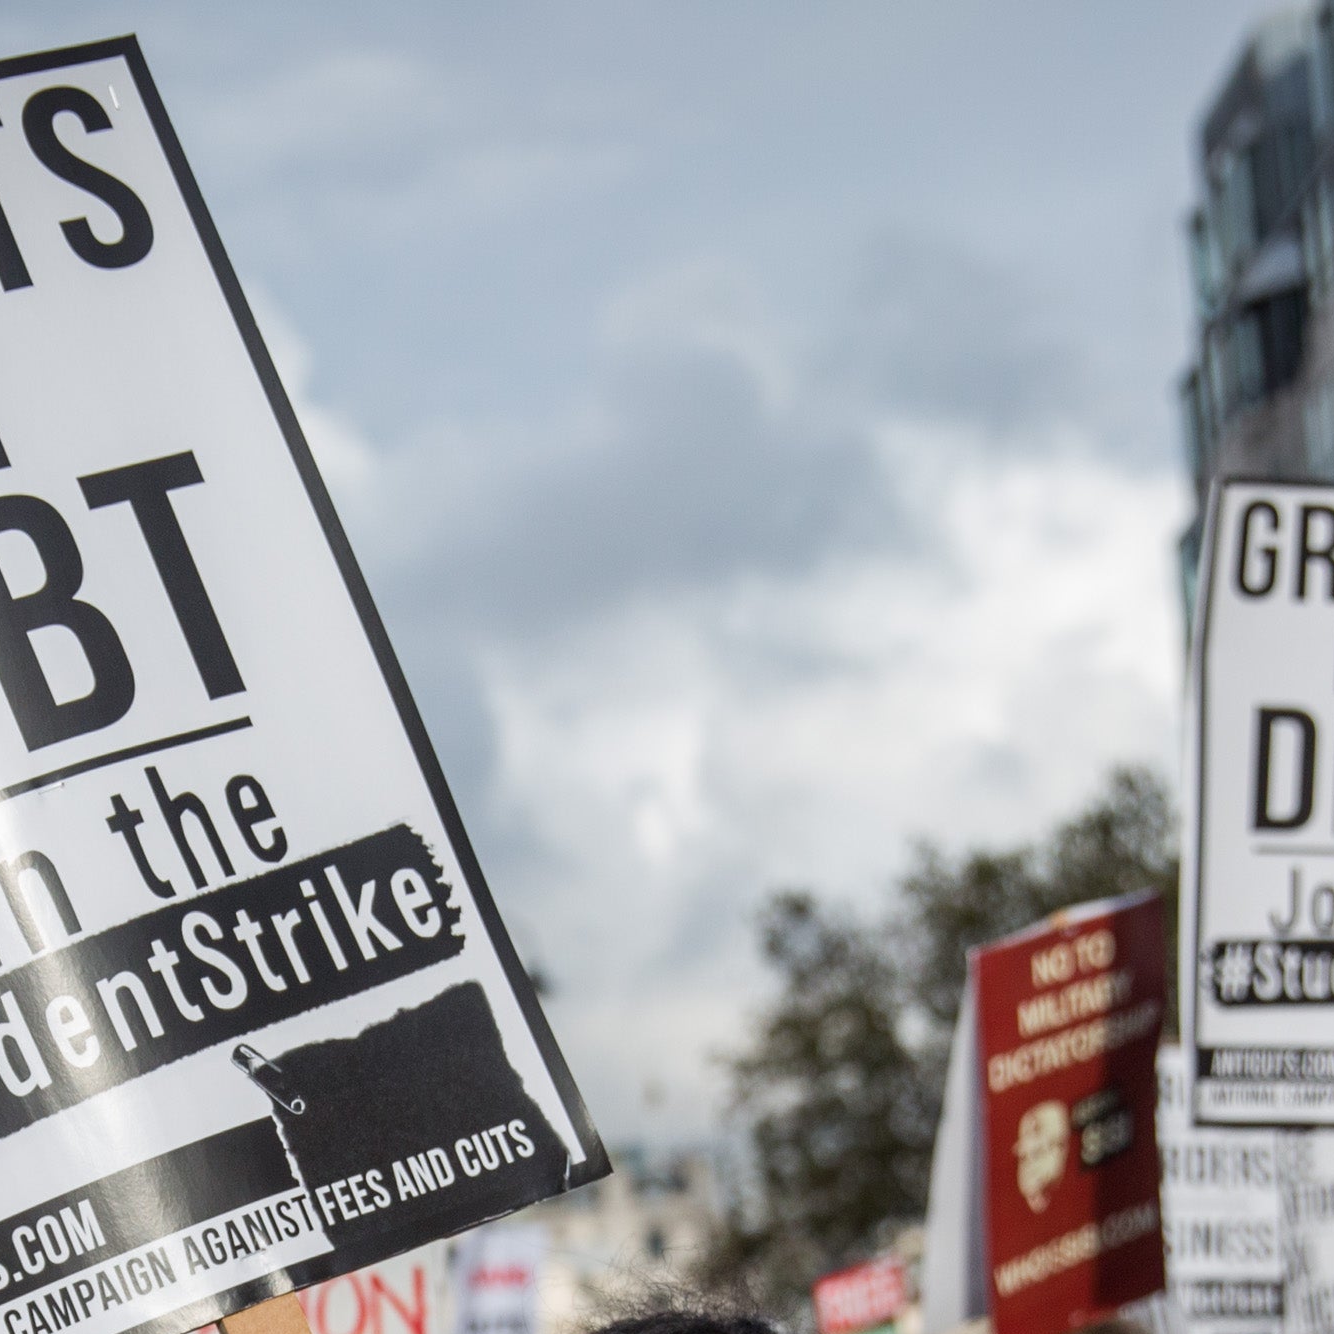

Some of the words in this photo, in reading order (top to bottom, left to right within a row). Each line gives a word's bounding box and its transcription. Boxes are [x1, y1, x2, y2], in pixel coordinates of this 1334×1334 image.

[106, 766, 289, 889] the
[1031, 944, 1076, 988] NO
[1077, 930, 1115, 972] TO
[182, 1194, 314, 1275] AGANIST
[315, 1169, 391, 1226] FEES
[392, 1147, 455, 1201] AND
[454, 1119, 535, 1177] CUTS
